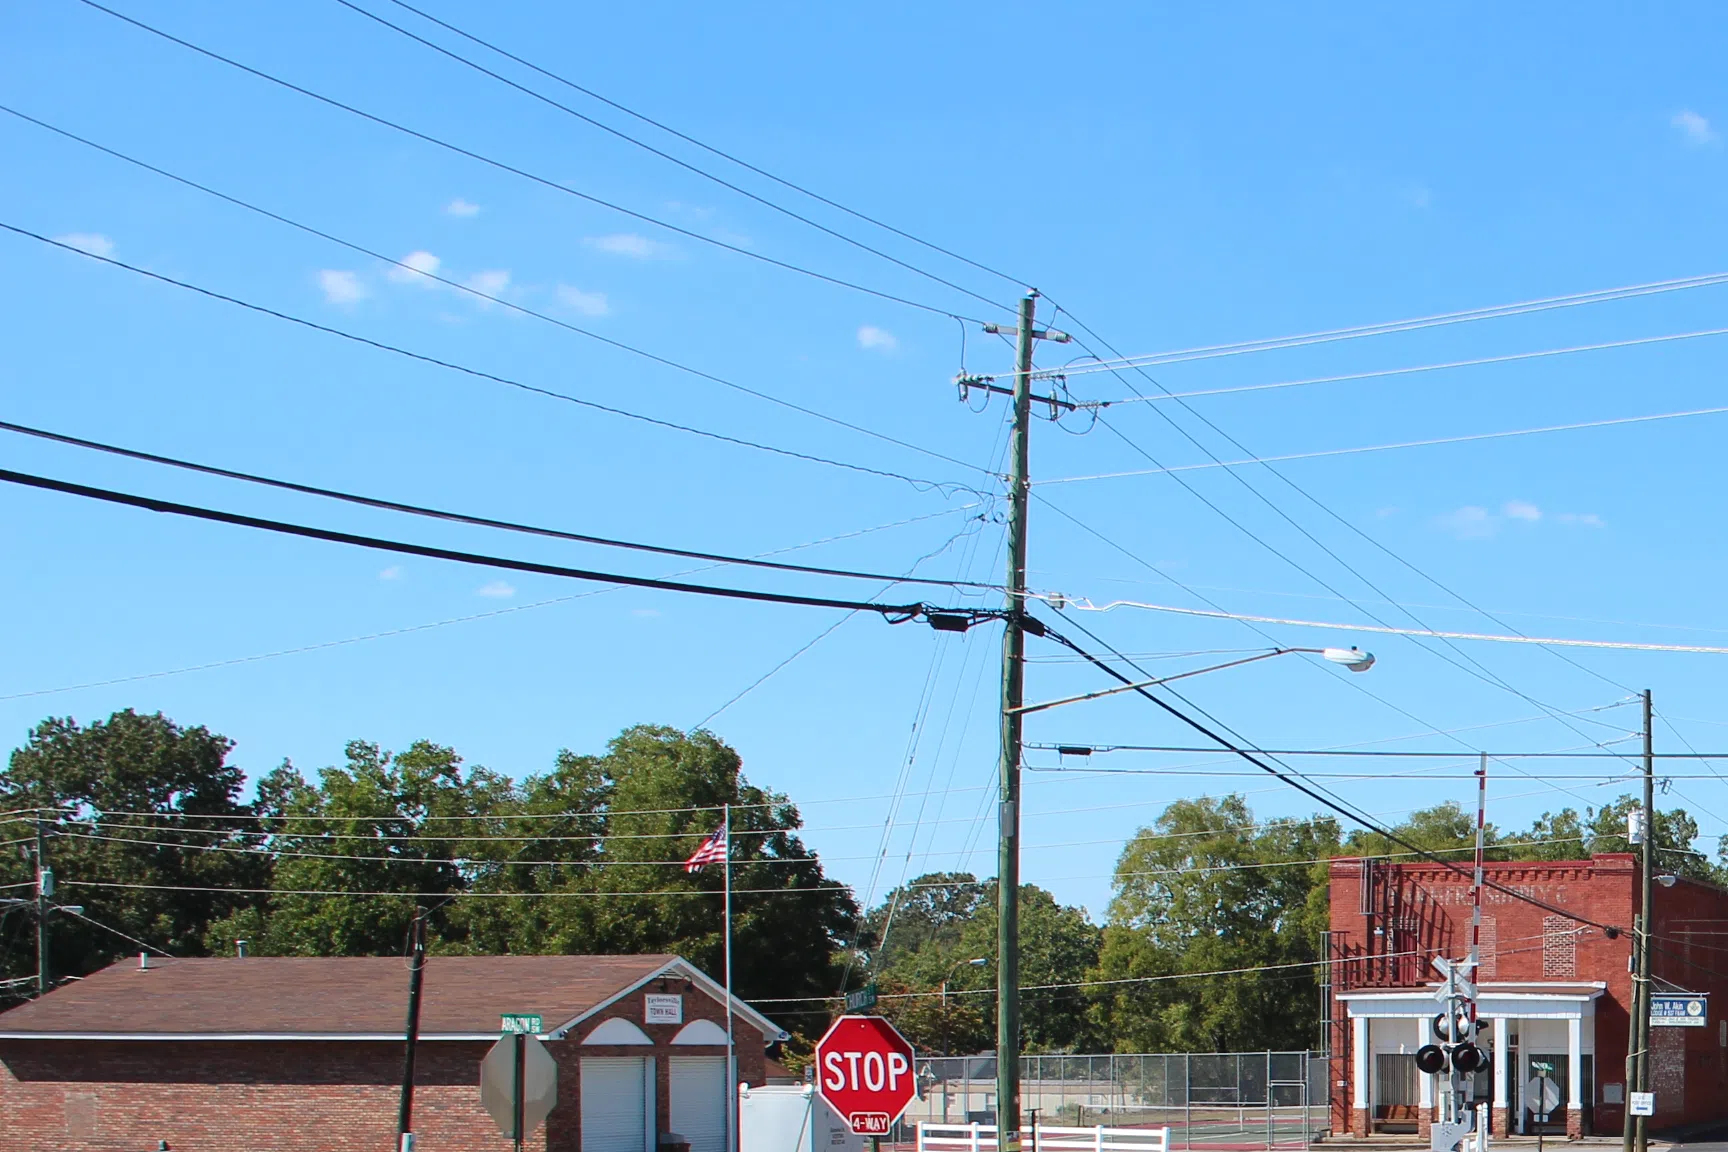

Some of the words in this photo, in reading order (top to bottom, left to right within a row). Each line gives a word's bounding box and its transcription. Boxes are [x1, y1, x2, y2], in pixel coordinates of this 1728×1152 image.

[650, 1007, 664, 1016] TOWN
[665, 1008, 677, 1016] HALL
[1651, 1001, 1663, 1010] John
[501, 1016, 530, 1032] ARAGON
[825, 1051, 908, 1091] STOP
[853, 1117, 887, 1131] 4-WAY
